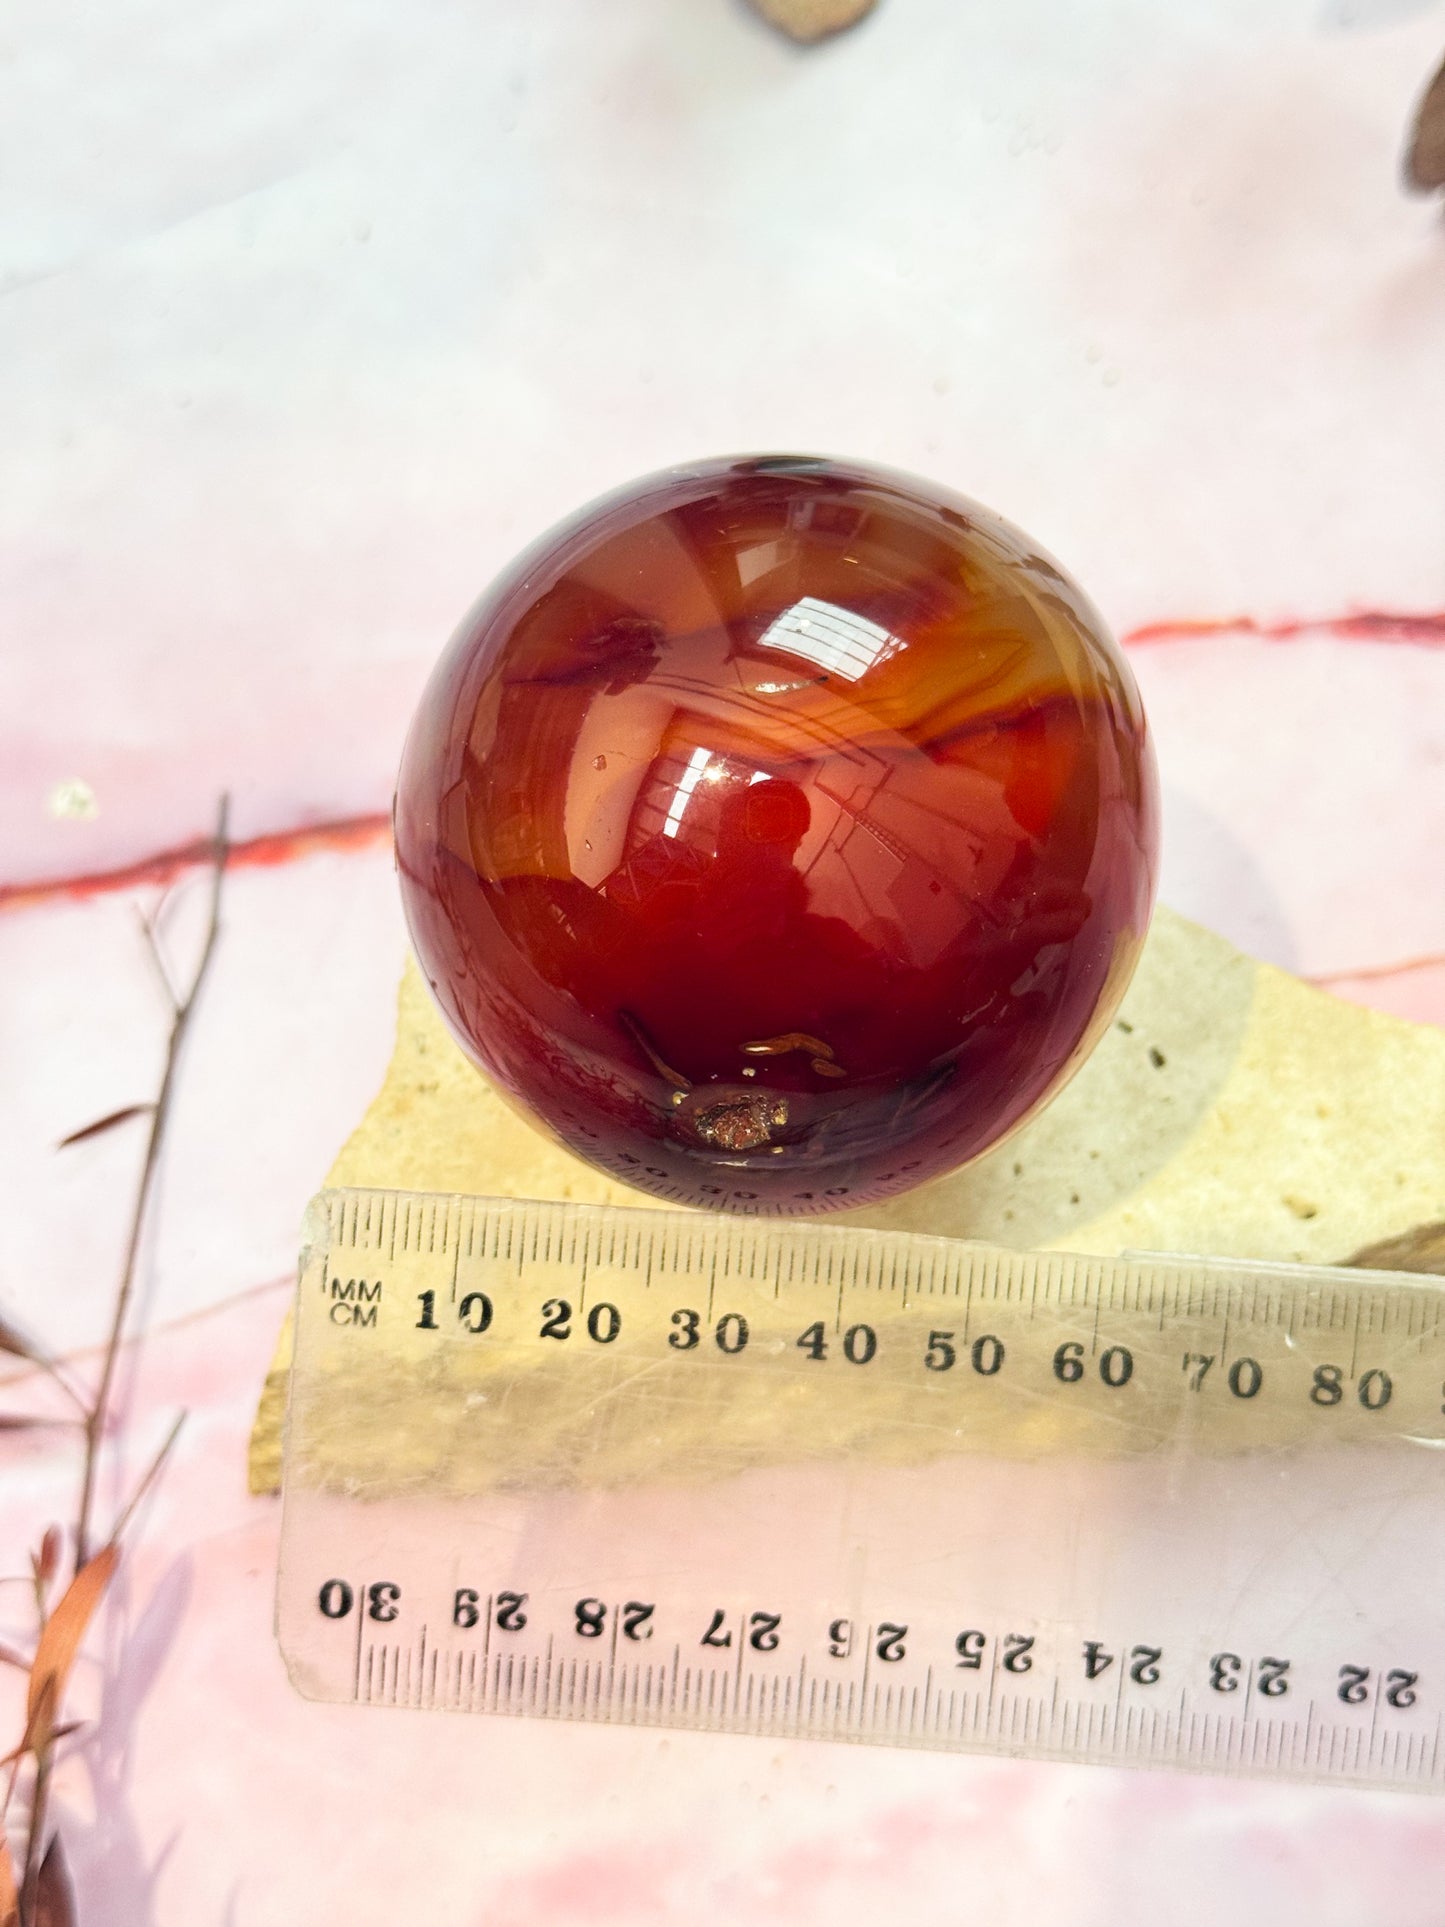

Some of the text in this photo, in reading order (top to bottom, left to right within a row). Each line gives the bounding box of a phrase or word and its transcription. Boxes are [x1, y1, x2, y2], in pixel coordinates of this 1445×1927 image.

[329, 1301, 378, 1328] CM
[331, 1277, 382, 1302] MM
[415, 1289, 494, 1333] 10
[539, 1298, 622, 1343] 20
[668, 1309, 750, 1354] 30
[796, 1321, 877, 1364] 40
[923, 1330, 1005, 1376] 50
[1053, 1342, 1134, 1387] 60
[1182, 1352, 1263, 1400] 70
[1310, 1364, 1393, 1410] 80
[318, 1577, 401, 1622] 30
[452, 1587, 529, 1632] 29
[574, 1597, 656, 1642] 28
[700, 1608, 782, 1651] 27
[955, 1629, 1036, 1674] 25
[1082, 1640, 1163, 1685] 24
[1209, 1652, 1291, 1697] 23
[1338, 1663, 1419, 1709] 22
